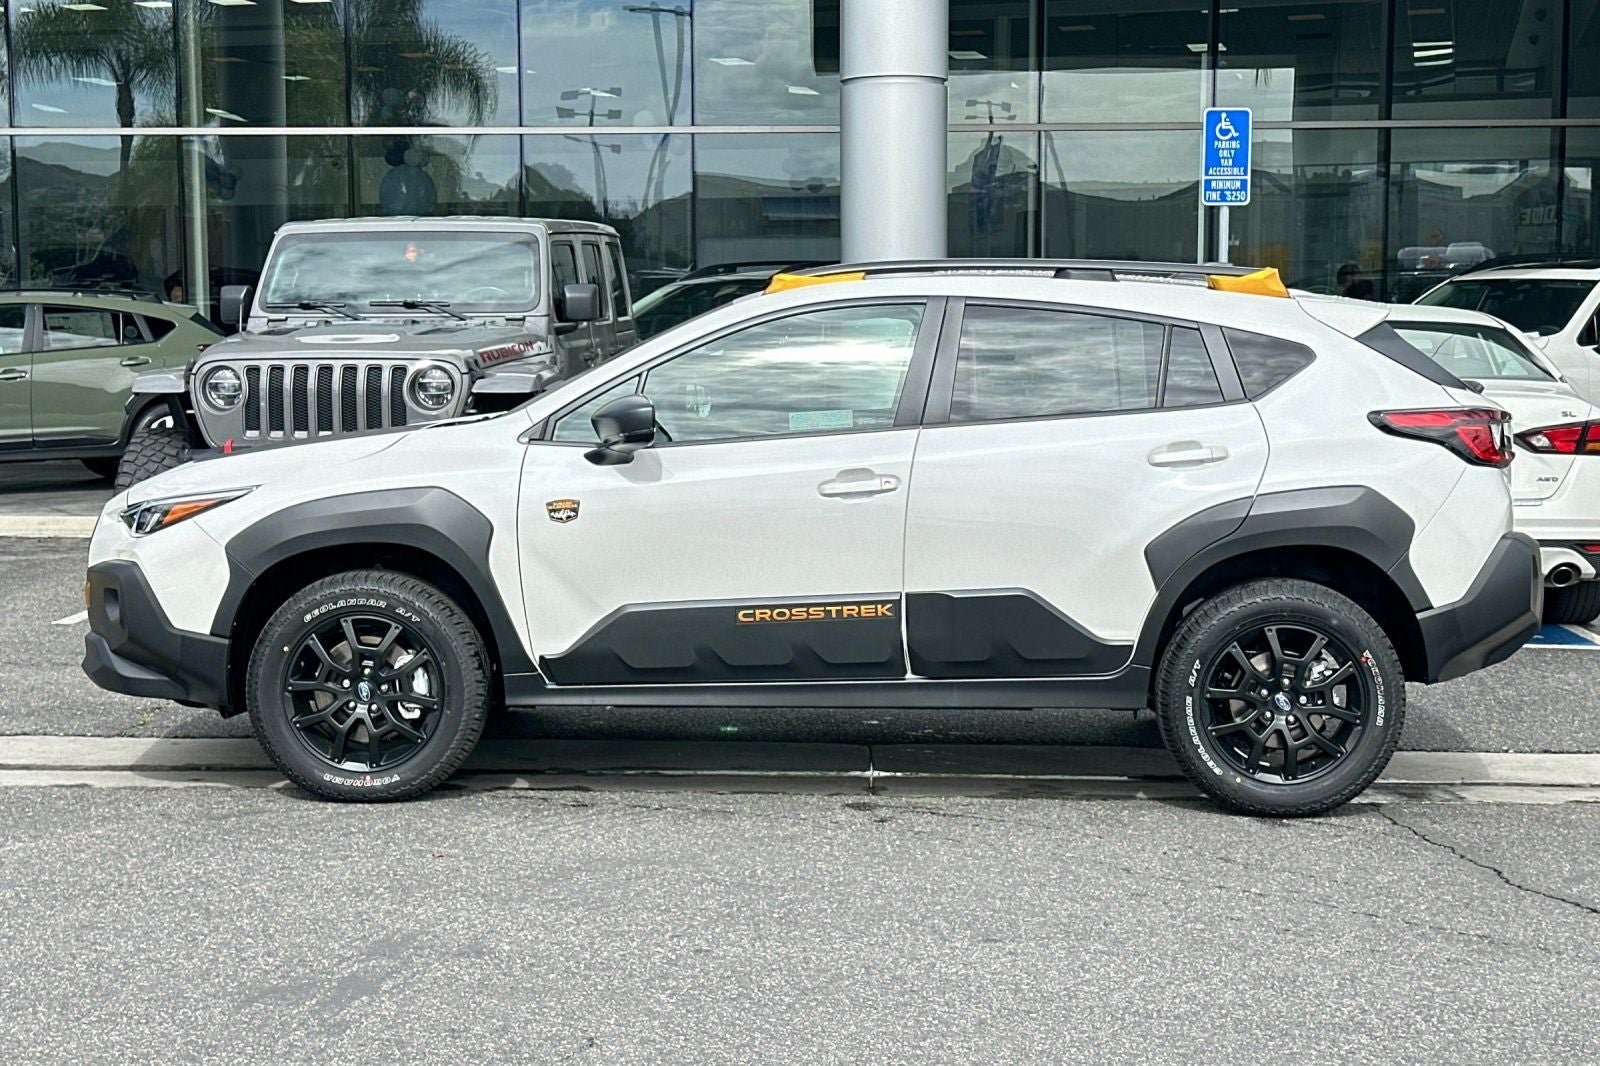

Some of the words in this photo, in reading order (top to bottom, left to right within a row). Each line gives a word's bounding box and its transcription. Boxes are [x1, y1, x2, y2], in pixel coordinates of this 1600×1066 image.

[1214, 140, 1240, 149] PARKING
[1219, 149, 1235, 158] ONLY
[1221, 158, 1233, 167] VAN
[1208, 167, 1245, 175] ACCESSIBLE
[1211, 180, 1241, 190] MINIMUM
[1205, 191, 1221, 201] FINE
[1224, 191, 1246, 201] $250
[479, 340, 534, 363] RUBICON
[303, 598, 388, 623] GEOLANDAR
[395, 606, 421, 623] A/T
[737, 603, 894, 622] CROSSTREK
[1188, 658, 1201, 688] A/T
[1362, 648, 1386, 727] YOKOHAMA
[1185, 695, 1223, 776] GEOLANDAR
[323, 772, 401, 787] YOKOHAMA
